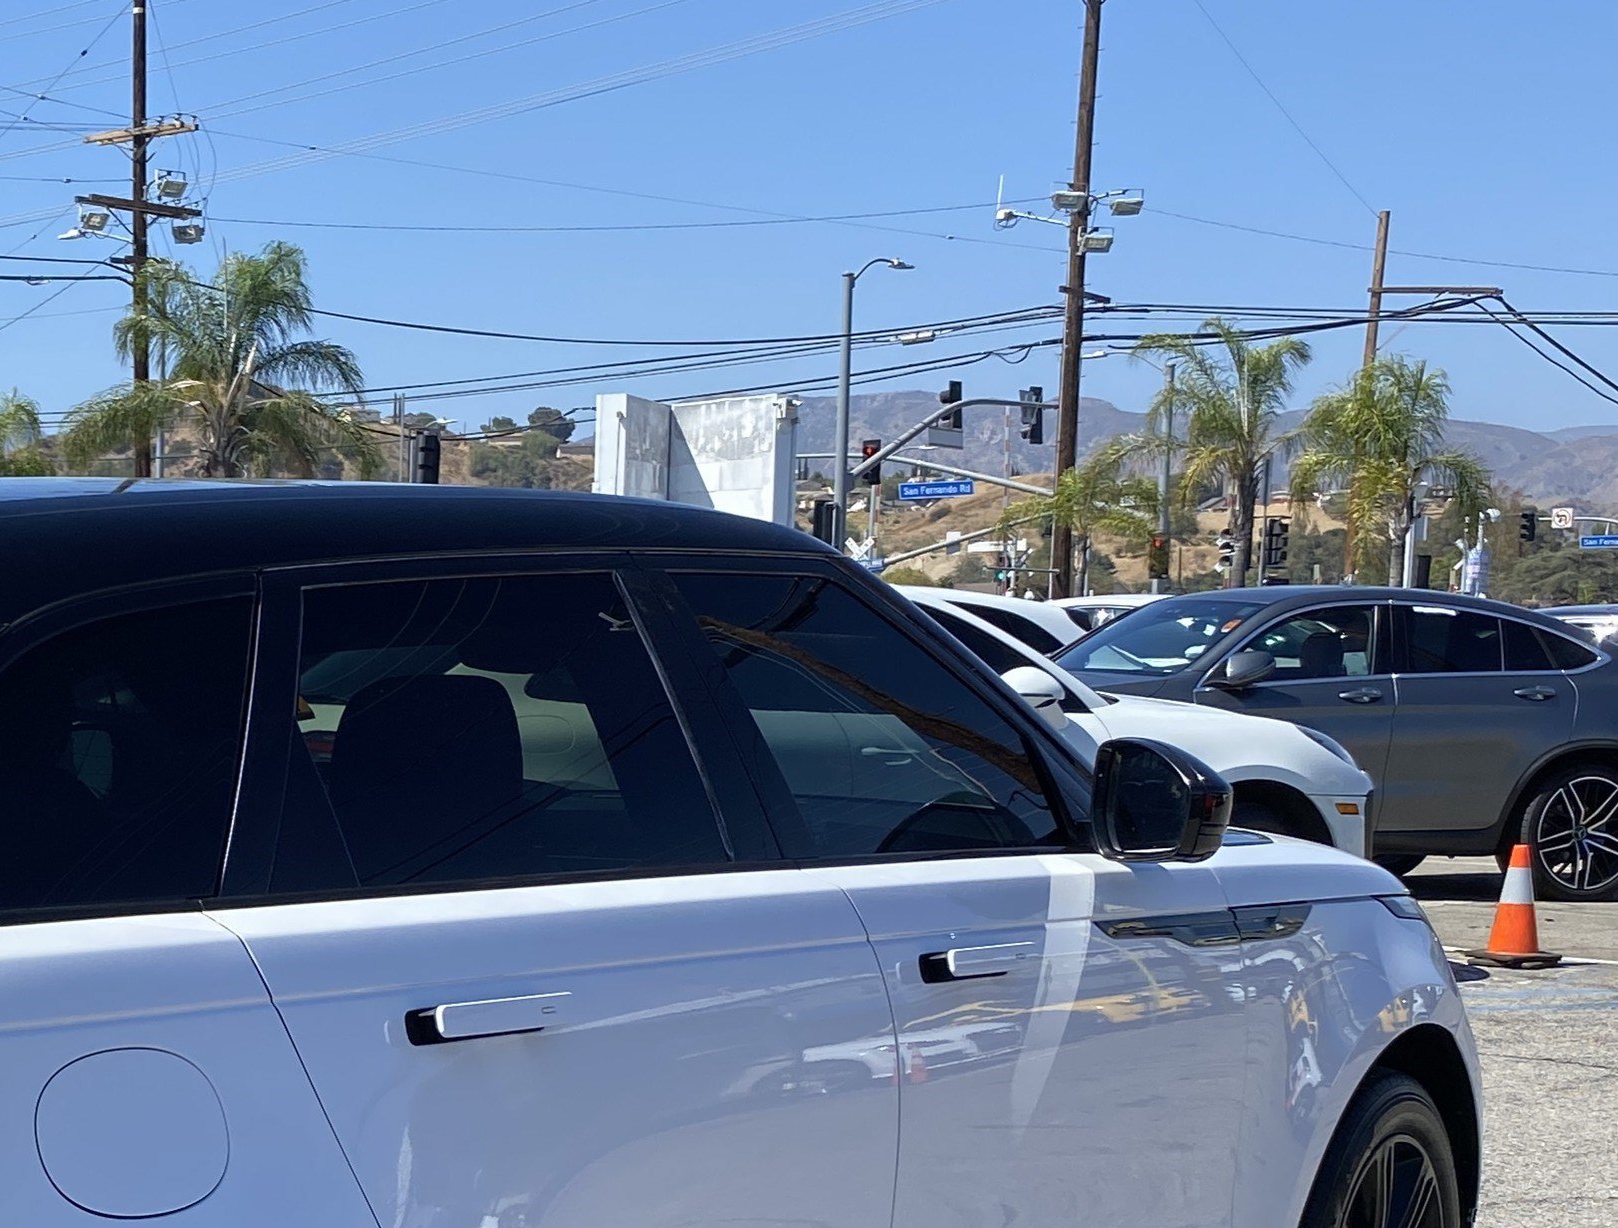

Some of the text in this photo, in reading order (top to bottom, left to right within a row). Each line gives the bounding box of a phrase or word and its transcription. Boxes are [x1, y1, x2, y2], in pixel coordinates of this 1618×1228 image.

[903, 483, 971, 496] San Fernando Rd
